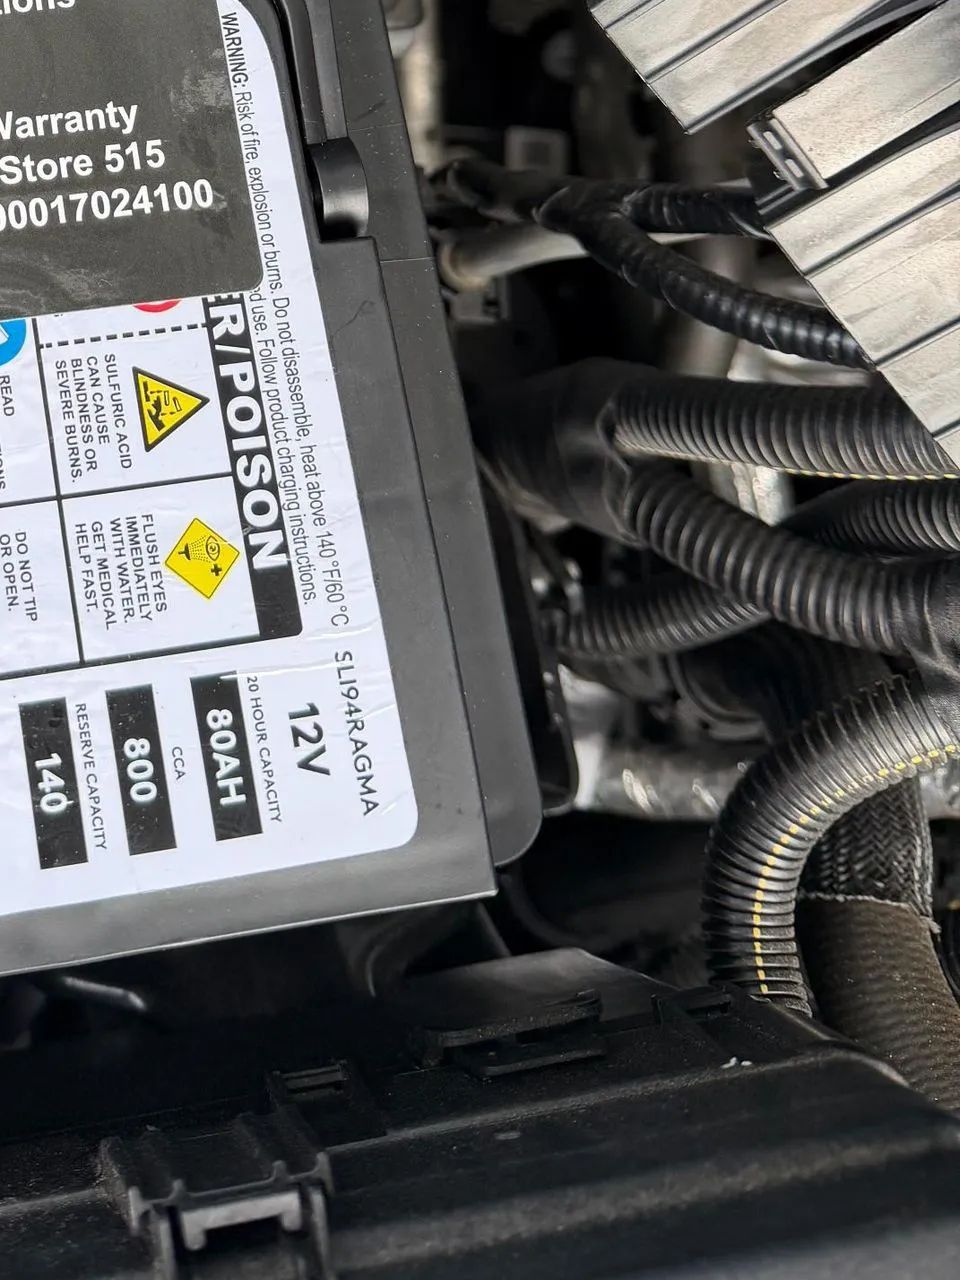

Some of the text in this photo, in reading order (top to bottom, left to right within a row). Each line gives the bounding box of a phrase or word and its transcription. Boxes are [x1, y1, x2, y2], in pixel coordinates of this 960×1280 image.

[218, 12, 248, 88] WARNING:
[234, 91, 256, 122] Risk
[240, 123, 260, 136] of
[105, 139, 165, 172] 515
[242, 138, 261, 164] fire,
[247, 167, 273, 231] explosion
[260, 233, 276, 248] or
[263, 250, 283, 295] burns.
[251, 305, 268, 336] use.
[271, 297, 291, 319] Do
[276, 321, 297, 345] not
[256, 338, 279, 385] Follow
[55, 359, 83, 483] SEVERE BURNS.
[70, 358, 98, 472] BLINDNESS OR
[86, 355, 111, 445] CAN CAUSE
[104, 353, 133, 469] SULFURIC ACID
[262, 389, 292, 444] product
[282, 349, 313, 441] disassemble,
[271, 447, 301, 511] charging
[299, 444, 322, 479] heat
[305, 480, 327, 527] above
[14, 531, 38, 622] DO NOT TIP
[74, 522, 99, 613] HELP FAST.
[91, 520, 118, 631] GET MEDICAL
[109, 517, 136, 624] WITH WATER.
[125, 515, 153, 621] IMMEDIATELY
[141, 513, 168, 613] FLUSH EYES
[288, 513, 317, 605] instructions.
[315, 530, 337, 559] 140
[2, 561, 20, 612] OPEN.
[171, 746, 187, 781] CCA
[207, 709, 246, 805] 80AH
[246, 675, 283, 823] 20 HOUR CAPACITY
[289, 703, 330, 775] 12V
[335, 651, 379, 816] SLI94RAGMA
[35, 753, 68, 814] 140
[75, 703, 108, 850] RESERVE CAPACITY
[124, 738, 157, 802] 800
